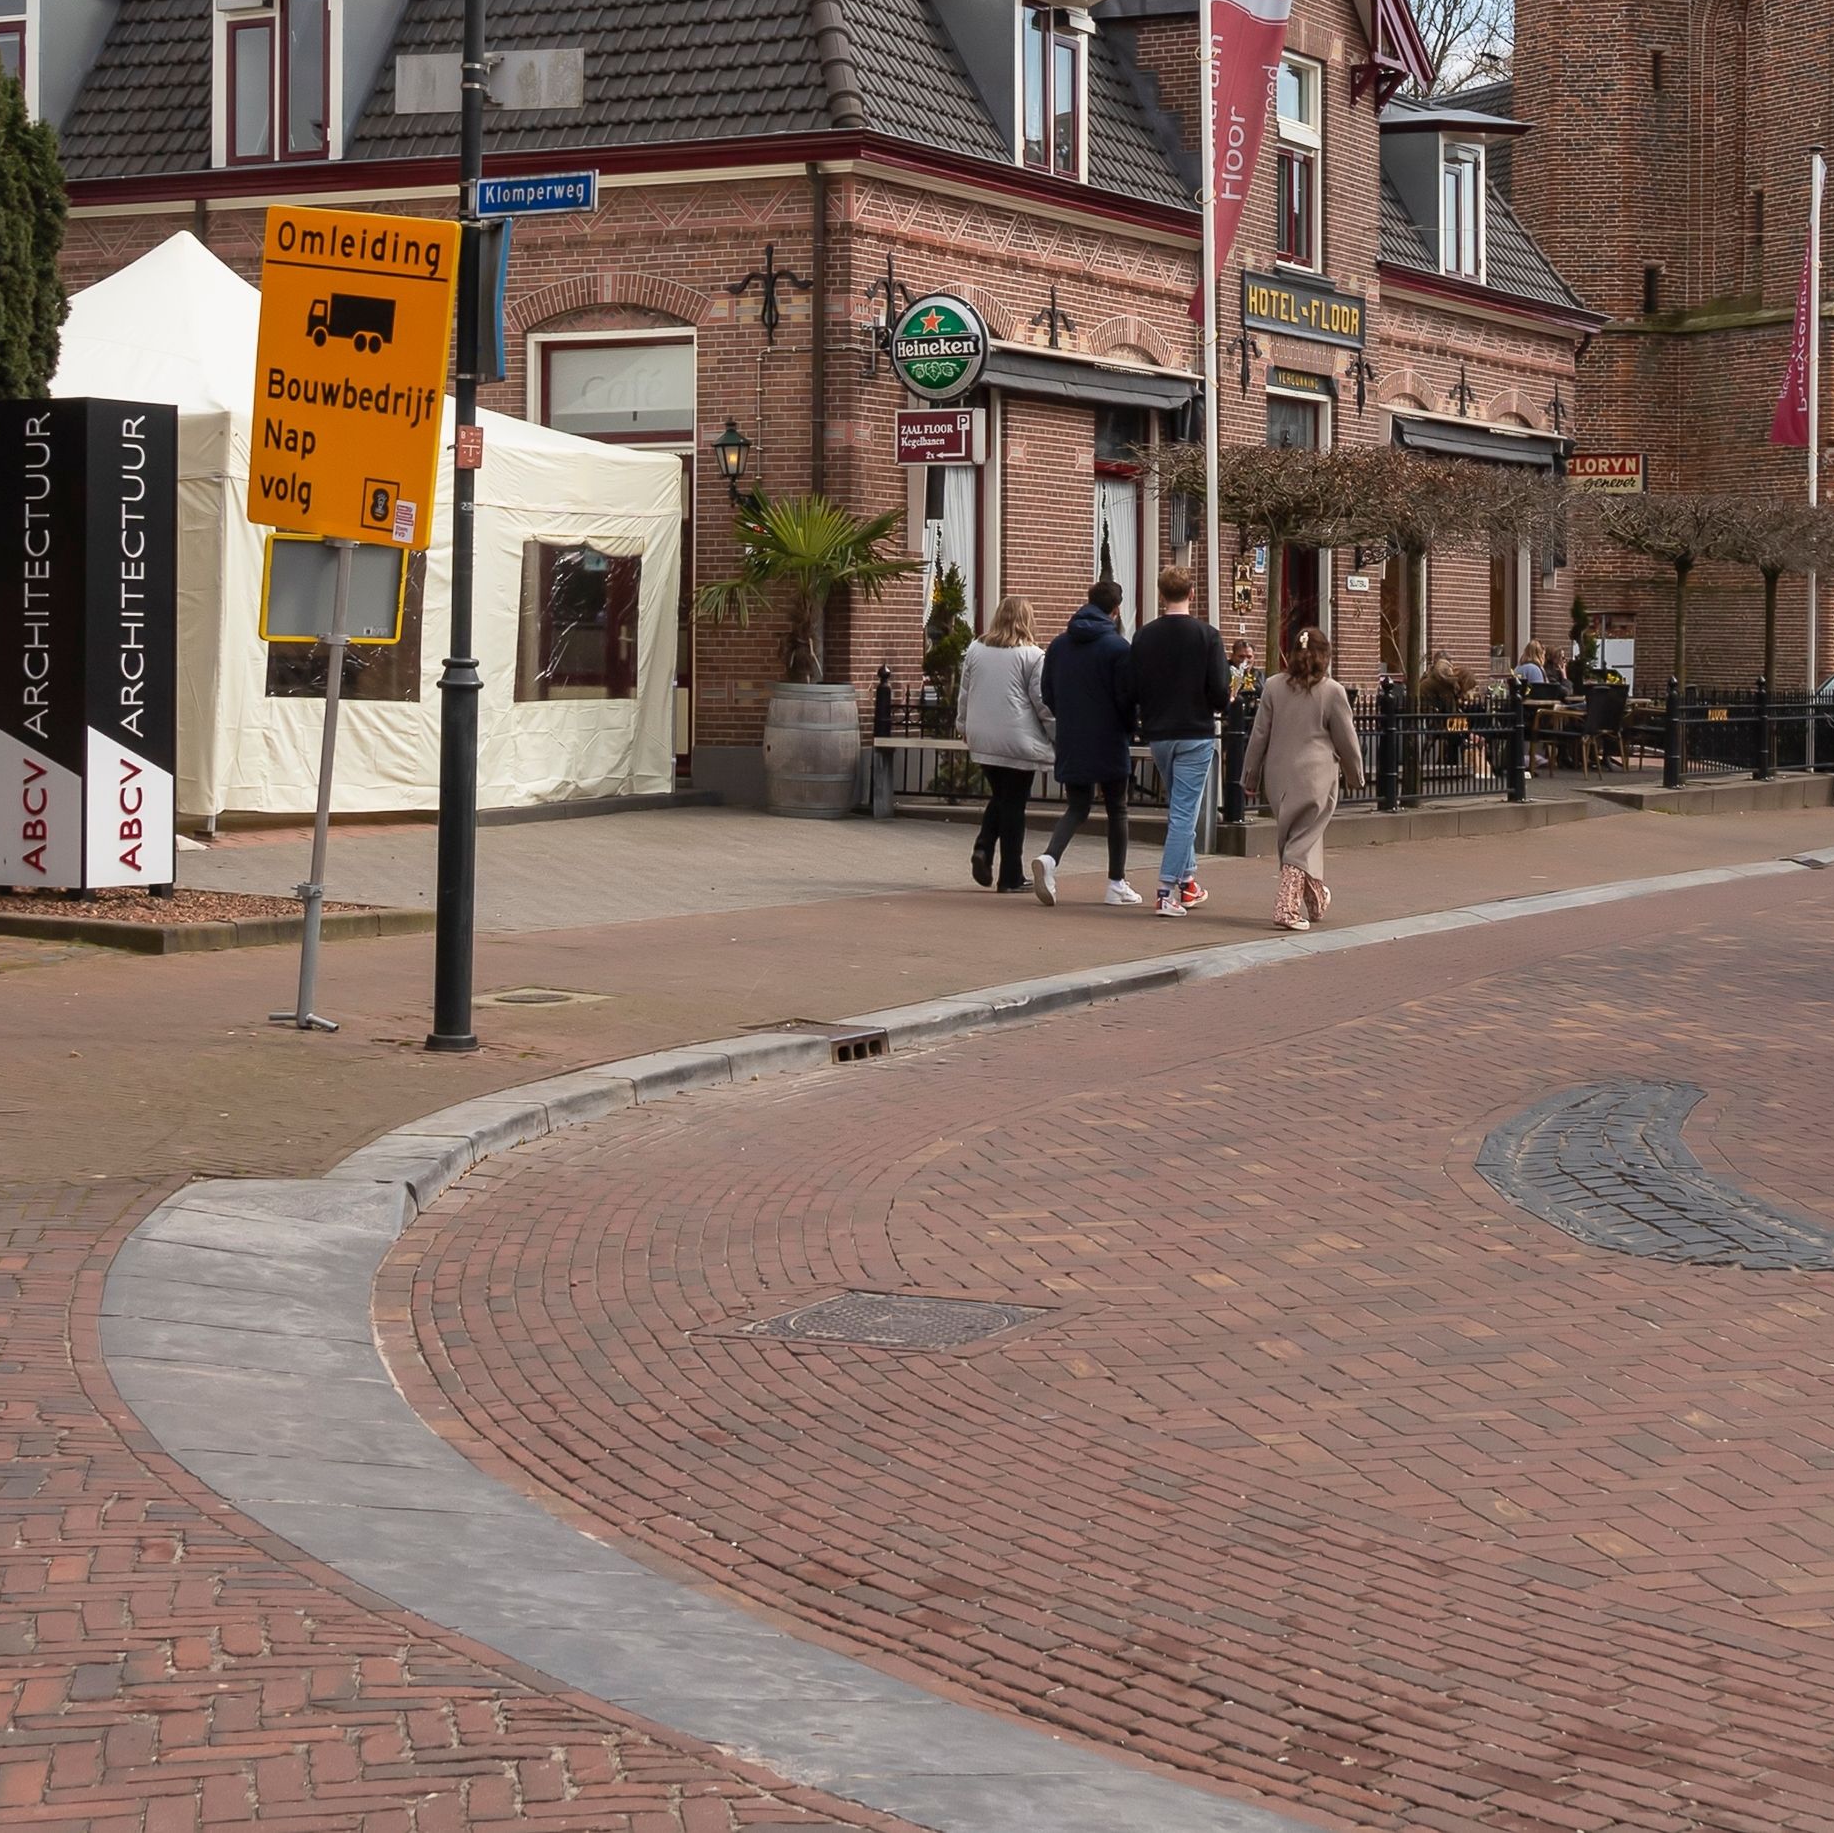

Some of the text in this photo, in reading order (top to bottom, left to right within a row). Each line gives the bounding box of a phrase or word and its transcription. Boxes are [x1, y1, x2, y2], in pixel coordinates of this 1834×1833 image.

[485, 183, 585, 206] Klomperweg
[277, 220, 441, 277] Omleiding
[897, 339, 976, 359] Heineken
[267, 367, 436, 429] Bouwbedrijf
[265, 418, 316, 460] Nap
[901, 423, 954, 435] ZAAL FLOOR
[901, 436, 945, 449] Kegelbanen
[1566, 457, 1636, 474] FLORYN
[260, 472, 312, 514] volg
[1583, 477, 1636, 492] genever
[22, 411, 51, 875] ABCV ARCHITECTUUR
[119, 414, 147, 872] ABCV ARCHITECTUUR
